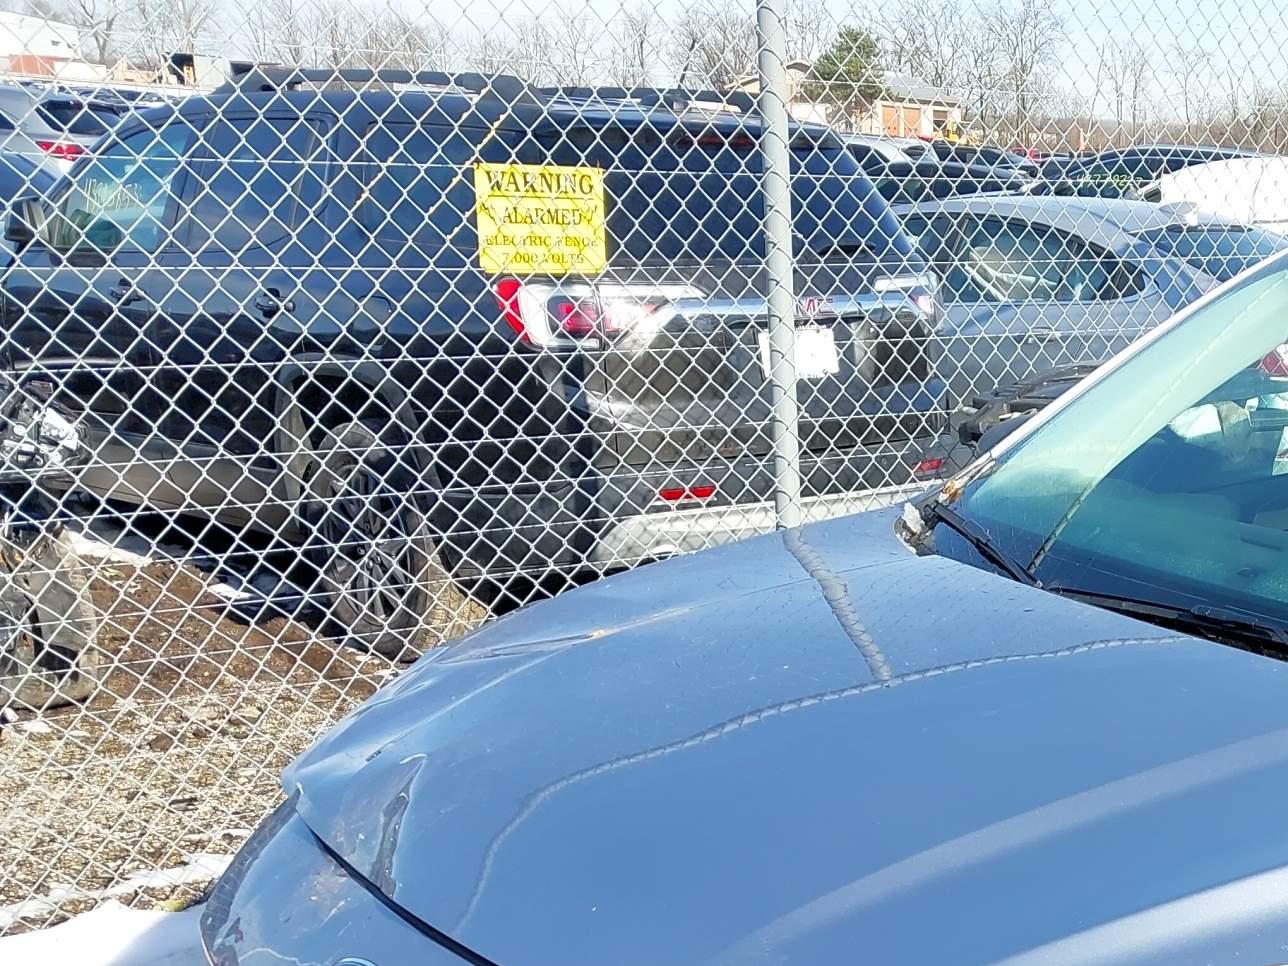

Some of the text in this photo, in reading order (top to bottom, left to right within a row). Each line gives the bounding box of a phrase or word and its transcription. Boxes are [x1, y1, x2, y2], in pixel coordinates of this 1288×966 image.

[486, 170, 594, 196] WARNING
[503, 206, 582, 225] ALARMED
[486, 235, 599, 247] ELECTRIC FENCE
[502, 252, 584, 265] 7,000 VOLTS
